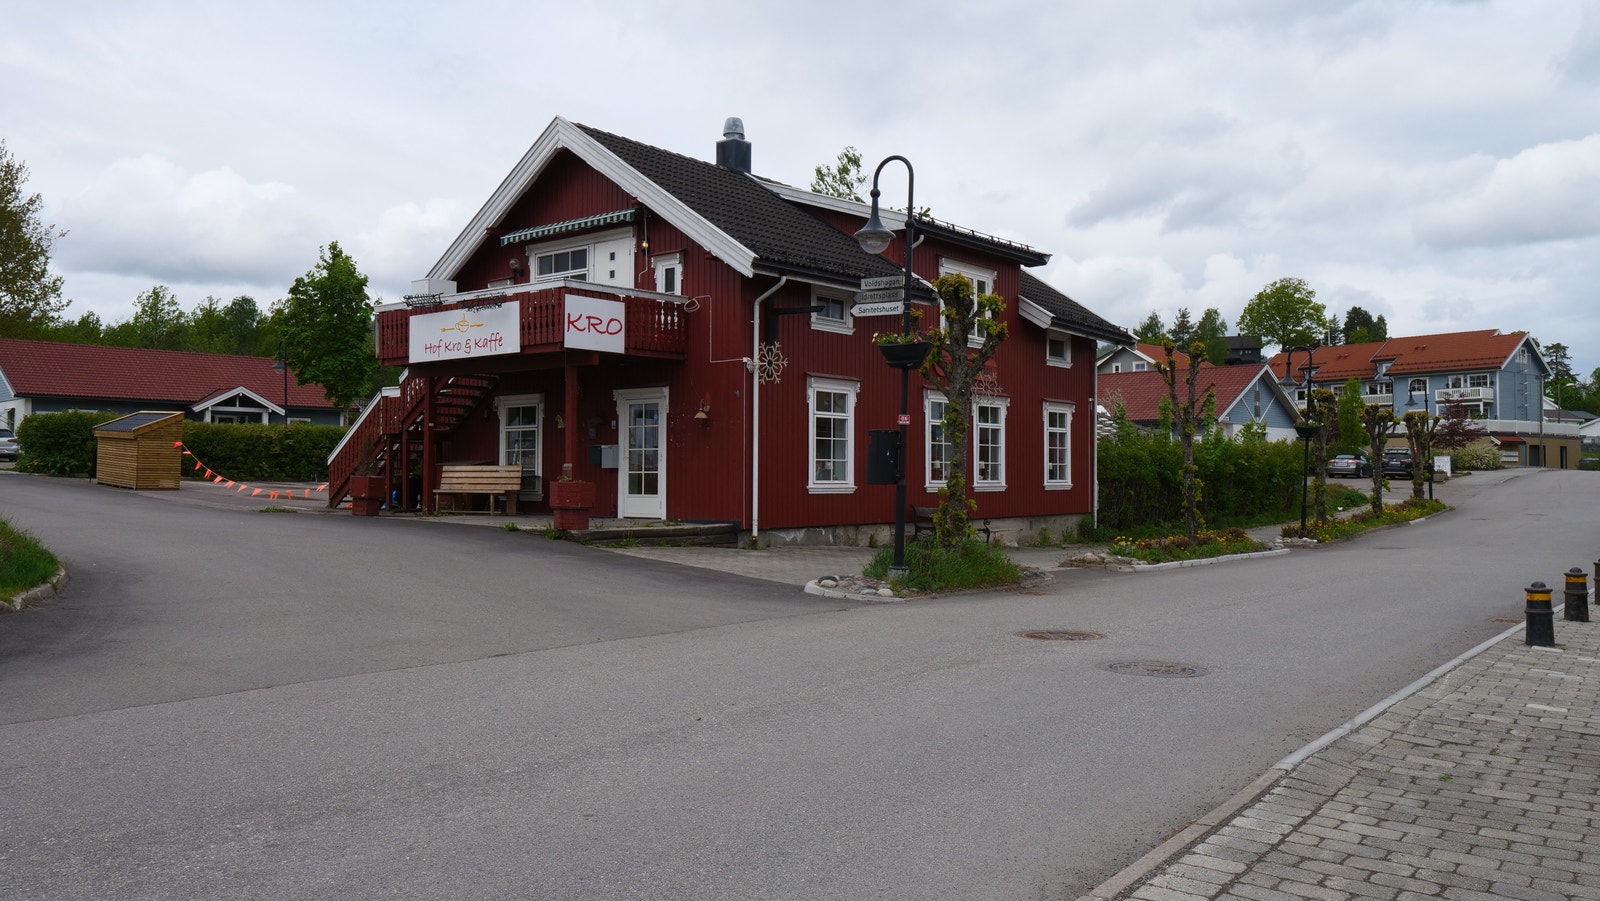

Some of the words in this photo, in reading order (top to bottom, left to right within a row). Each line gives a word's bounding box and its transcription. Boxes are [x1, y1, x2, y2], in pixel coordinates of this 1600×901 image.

[864, 279, 900, 287] Voldshagan
[861, 292, 898, 300] Idrettsplass
[858, 305, 899, 314] Sanitetshuset
[566, 313, 623, 335] KRO
[424, 339, 442, 357] Hof
[444, 341, 462, 354] Kro
[464, 339, 472, 353] &
[474, 332, 504, 353] Kaffe
